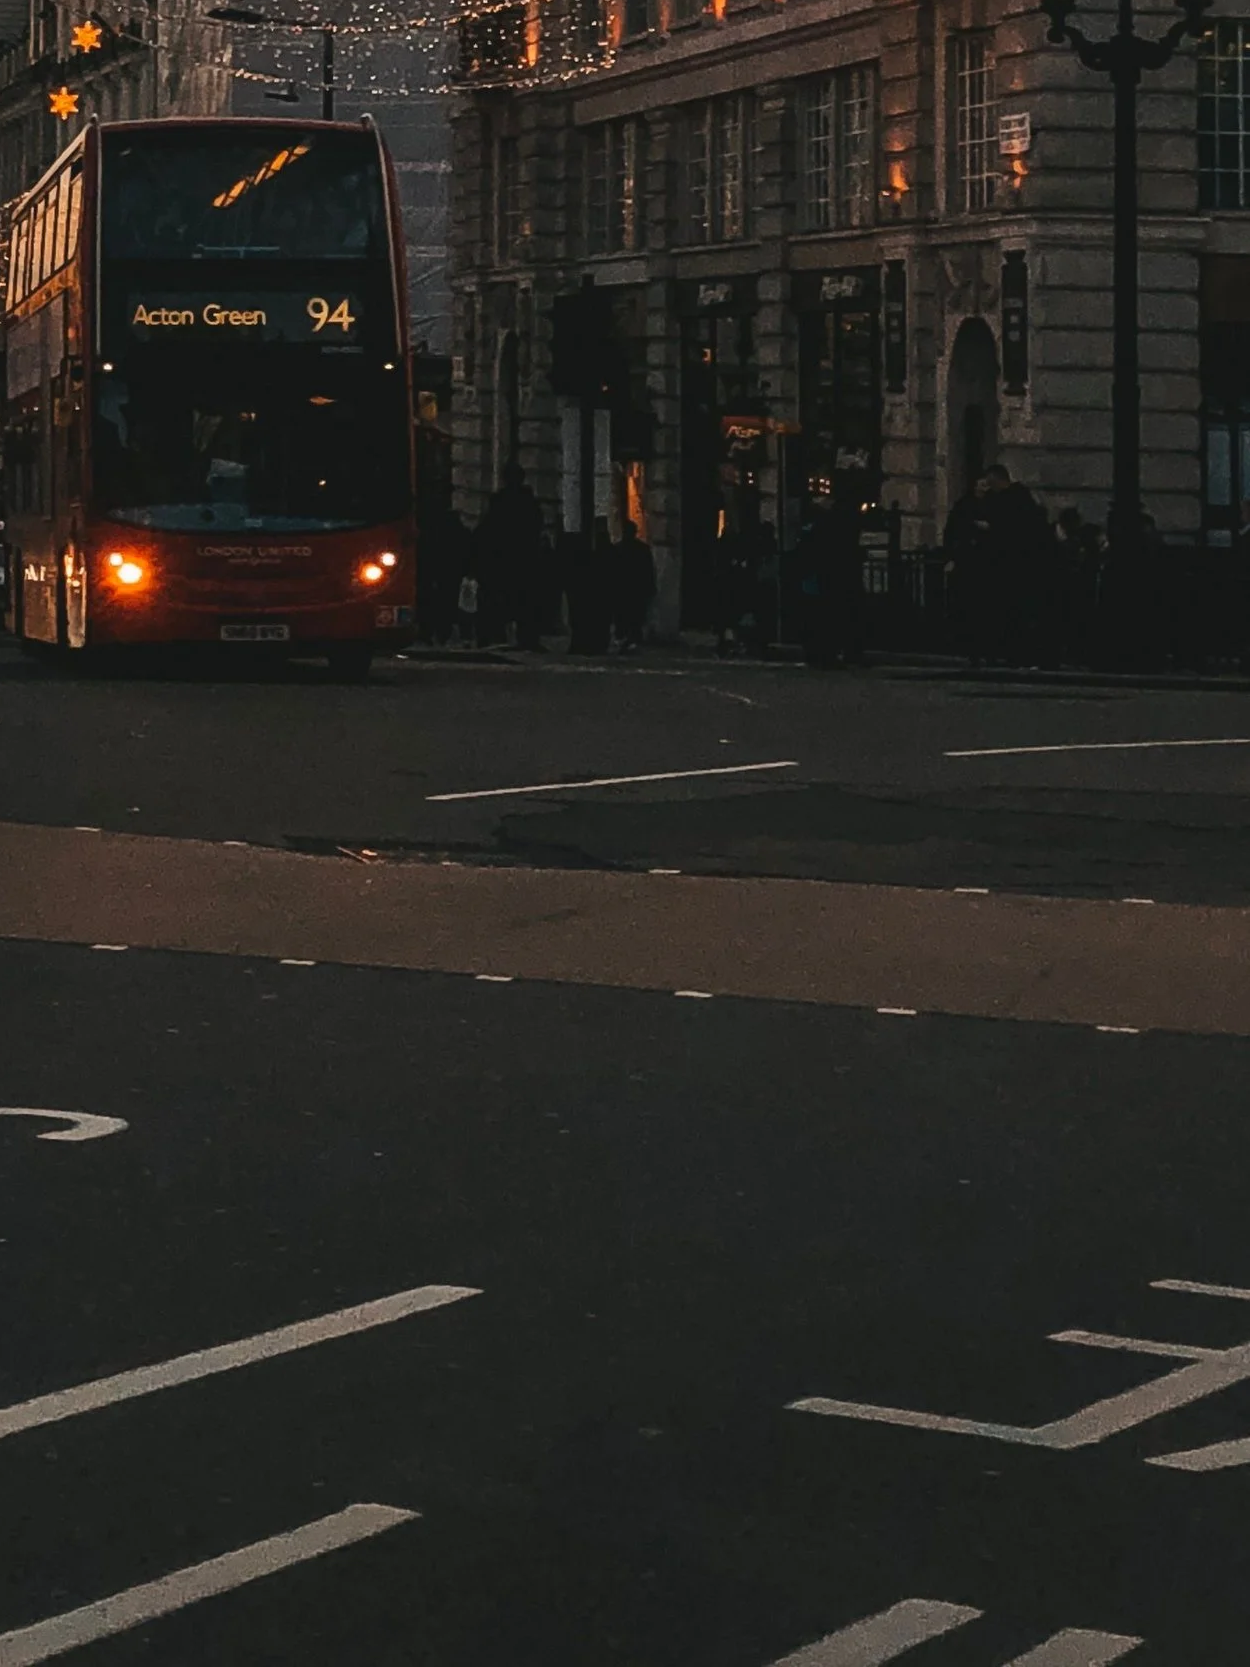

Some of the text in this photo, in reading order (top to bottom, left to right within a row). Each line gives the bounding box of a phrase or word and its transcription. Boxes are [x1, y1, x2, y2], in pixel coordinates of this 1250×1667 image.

[133, 303, 267, 325] Acton Green
[306, 297, 356, 332] 94
[196, 546, 313, 557] LONDON UNITED
